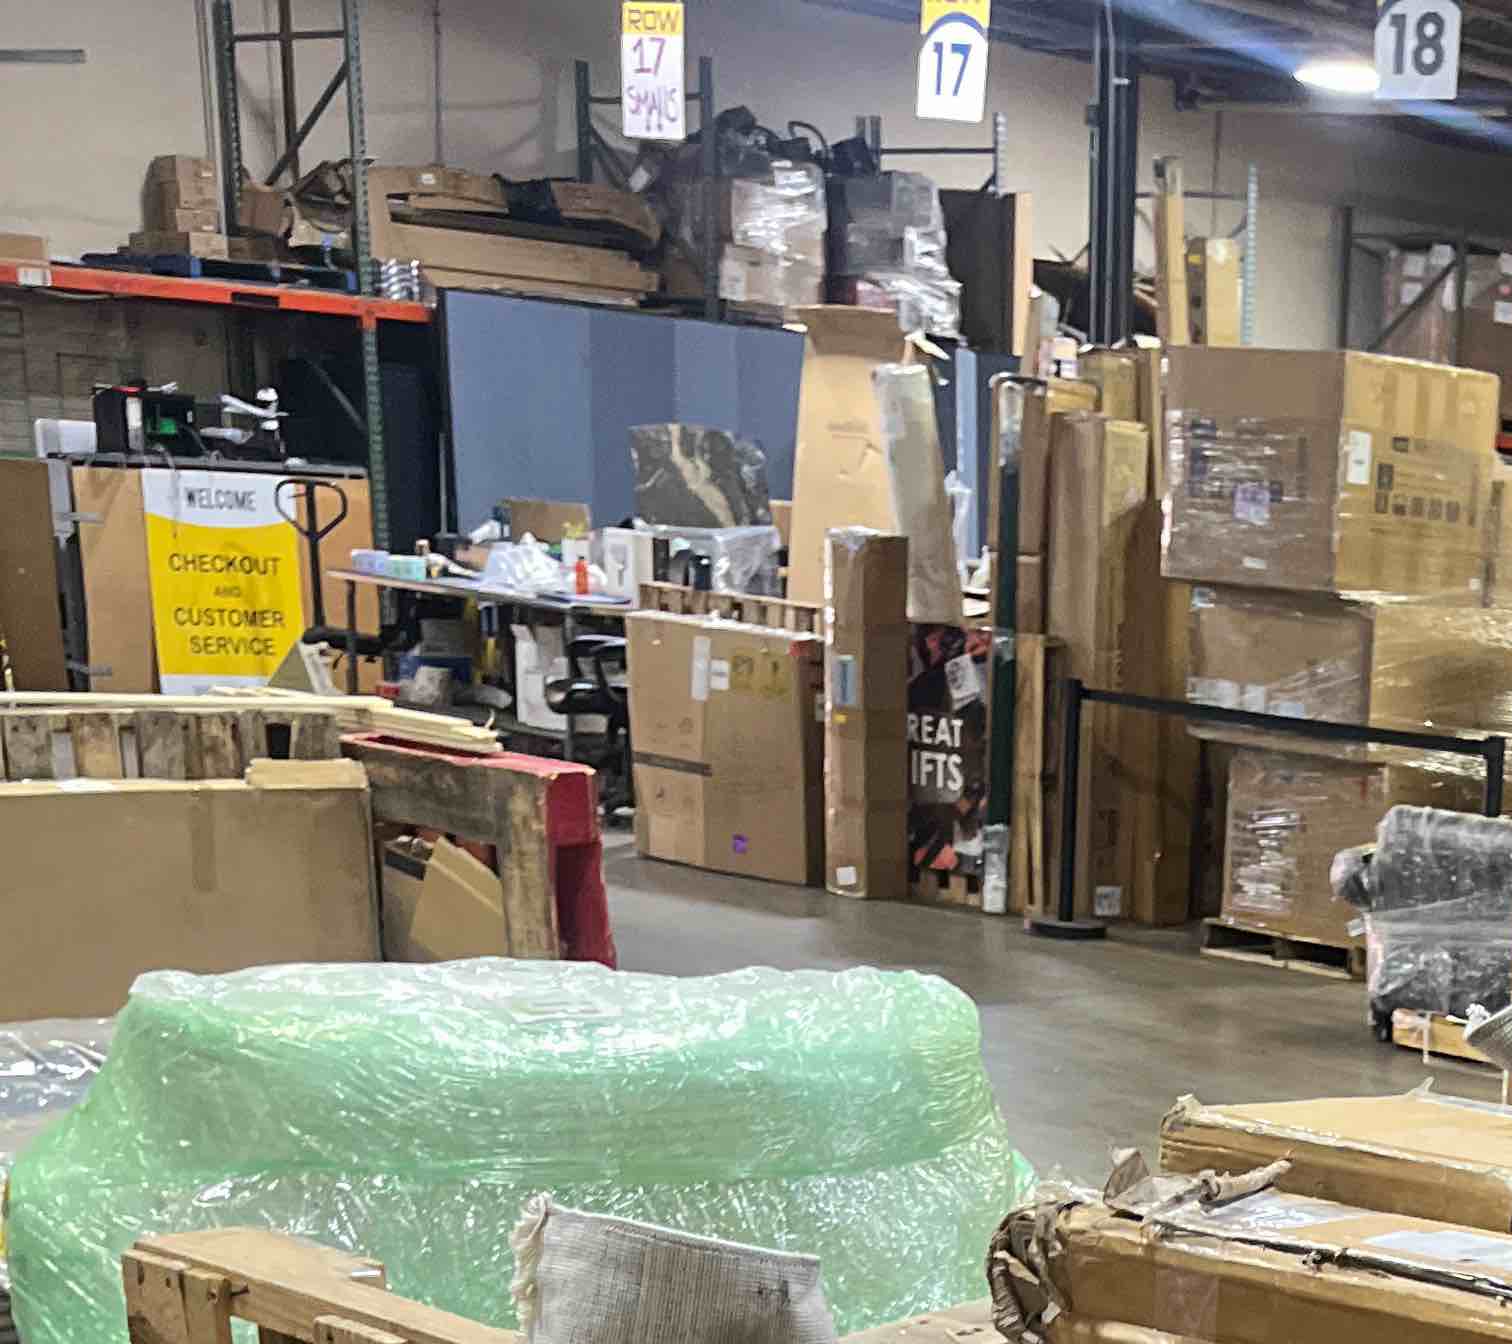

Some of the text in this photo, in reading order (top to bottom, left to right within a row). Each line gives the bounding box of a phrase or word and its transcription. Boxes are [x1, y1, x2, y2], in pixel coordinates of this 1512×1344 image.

[628, 9, 680, 31] ROW
[633, 36, 666, 76] 17
[1389, 11, 1446, 76] 18
[932, 40, 972, 97] 17
[184, 487, 257, 511] WELCOME
[167, 553, 282, 576] CHECKOUT
[173, 607, 286, 629] CUSTOMER
[189, 635, 277, 656] SERVICE
[906, 713, 963, 748] REAT
[911, 752, 964, 792] IFTS
